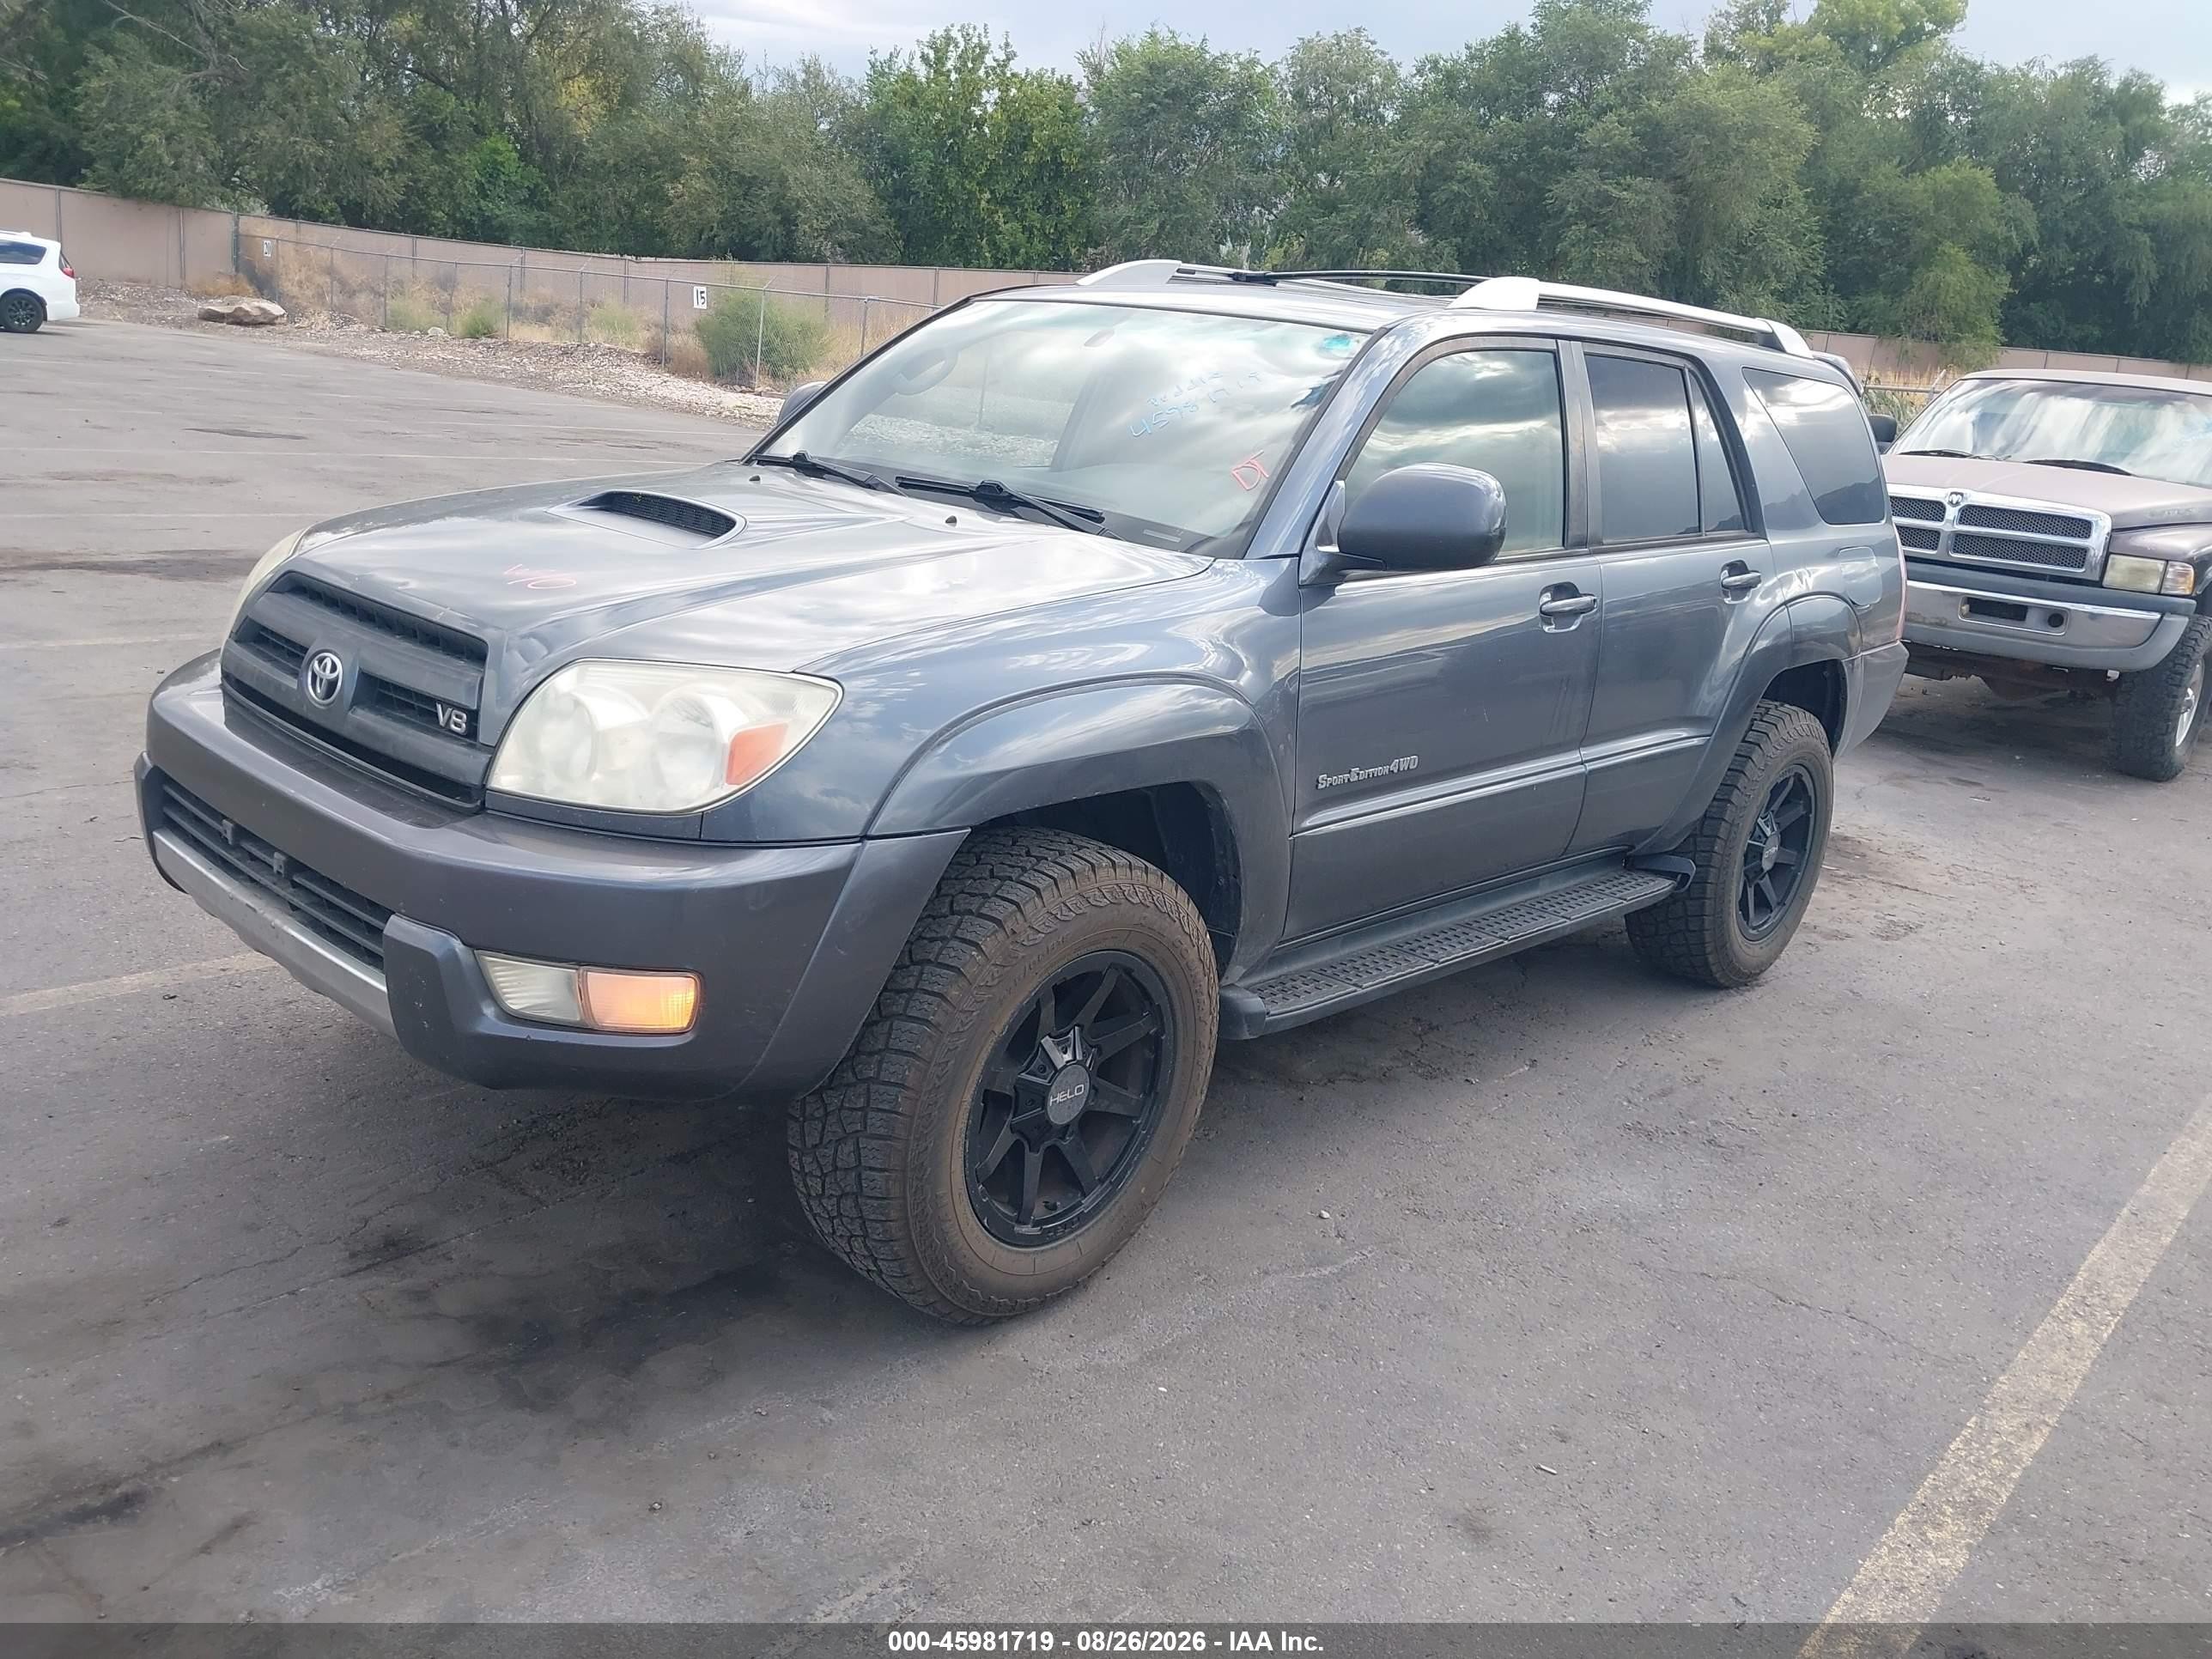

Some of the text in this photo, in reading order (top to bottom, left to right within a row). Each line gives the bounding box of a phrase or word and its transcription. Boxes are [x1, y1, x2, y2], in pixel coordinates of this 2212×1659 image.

[696, 289, 706, 305] 15
[1231, 449, 1269, 491] DT
[436, 702, 467, 735] V8
[1390, 756, 1419, 773] 4WD
[1049, 1084, 1085, 1107] HELO
